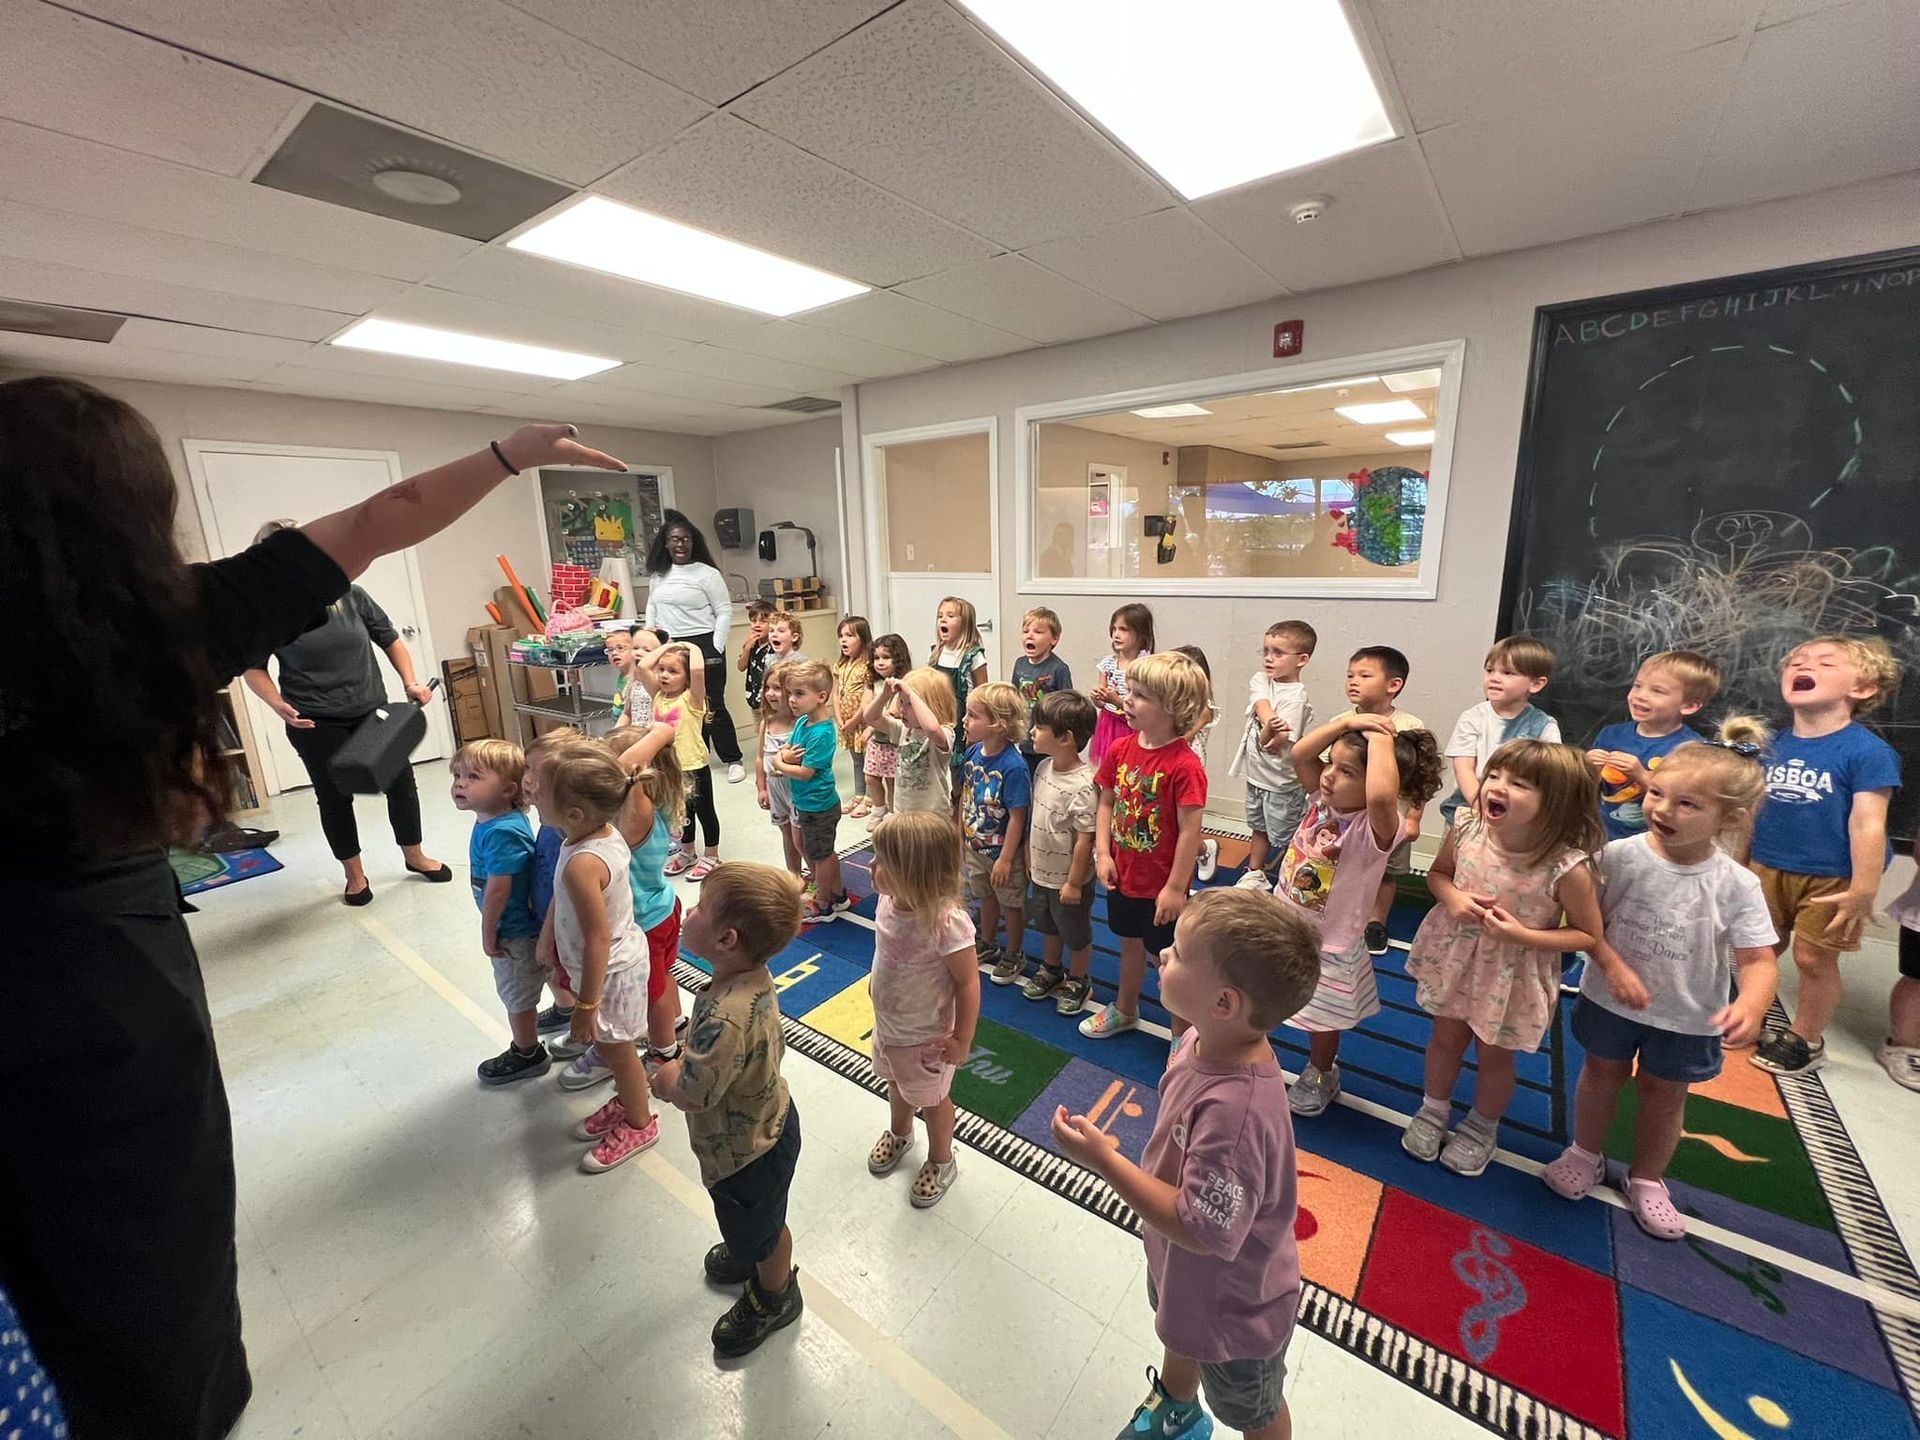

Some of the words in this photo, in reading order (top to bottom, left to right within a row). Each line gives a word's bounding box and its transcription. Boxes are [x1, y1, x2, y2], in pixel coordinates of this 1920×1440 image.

[1765, 765, 1833, 793] ISBOA
[1207, 1172, 1244, 1201] PEACE
[1193, 1198, 1235, 1230] MUSIC
